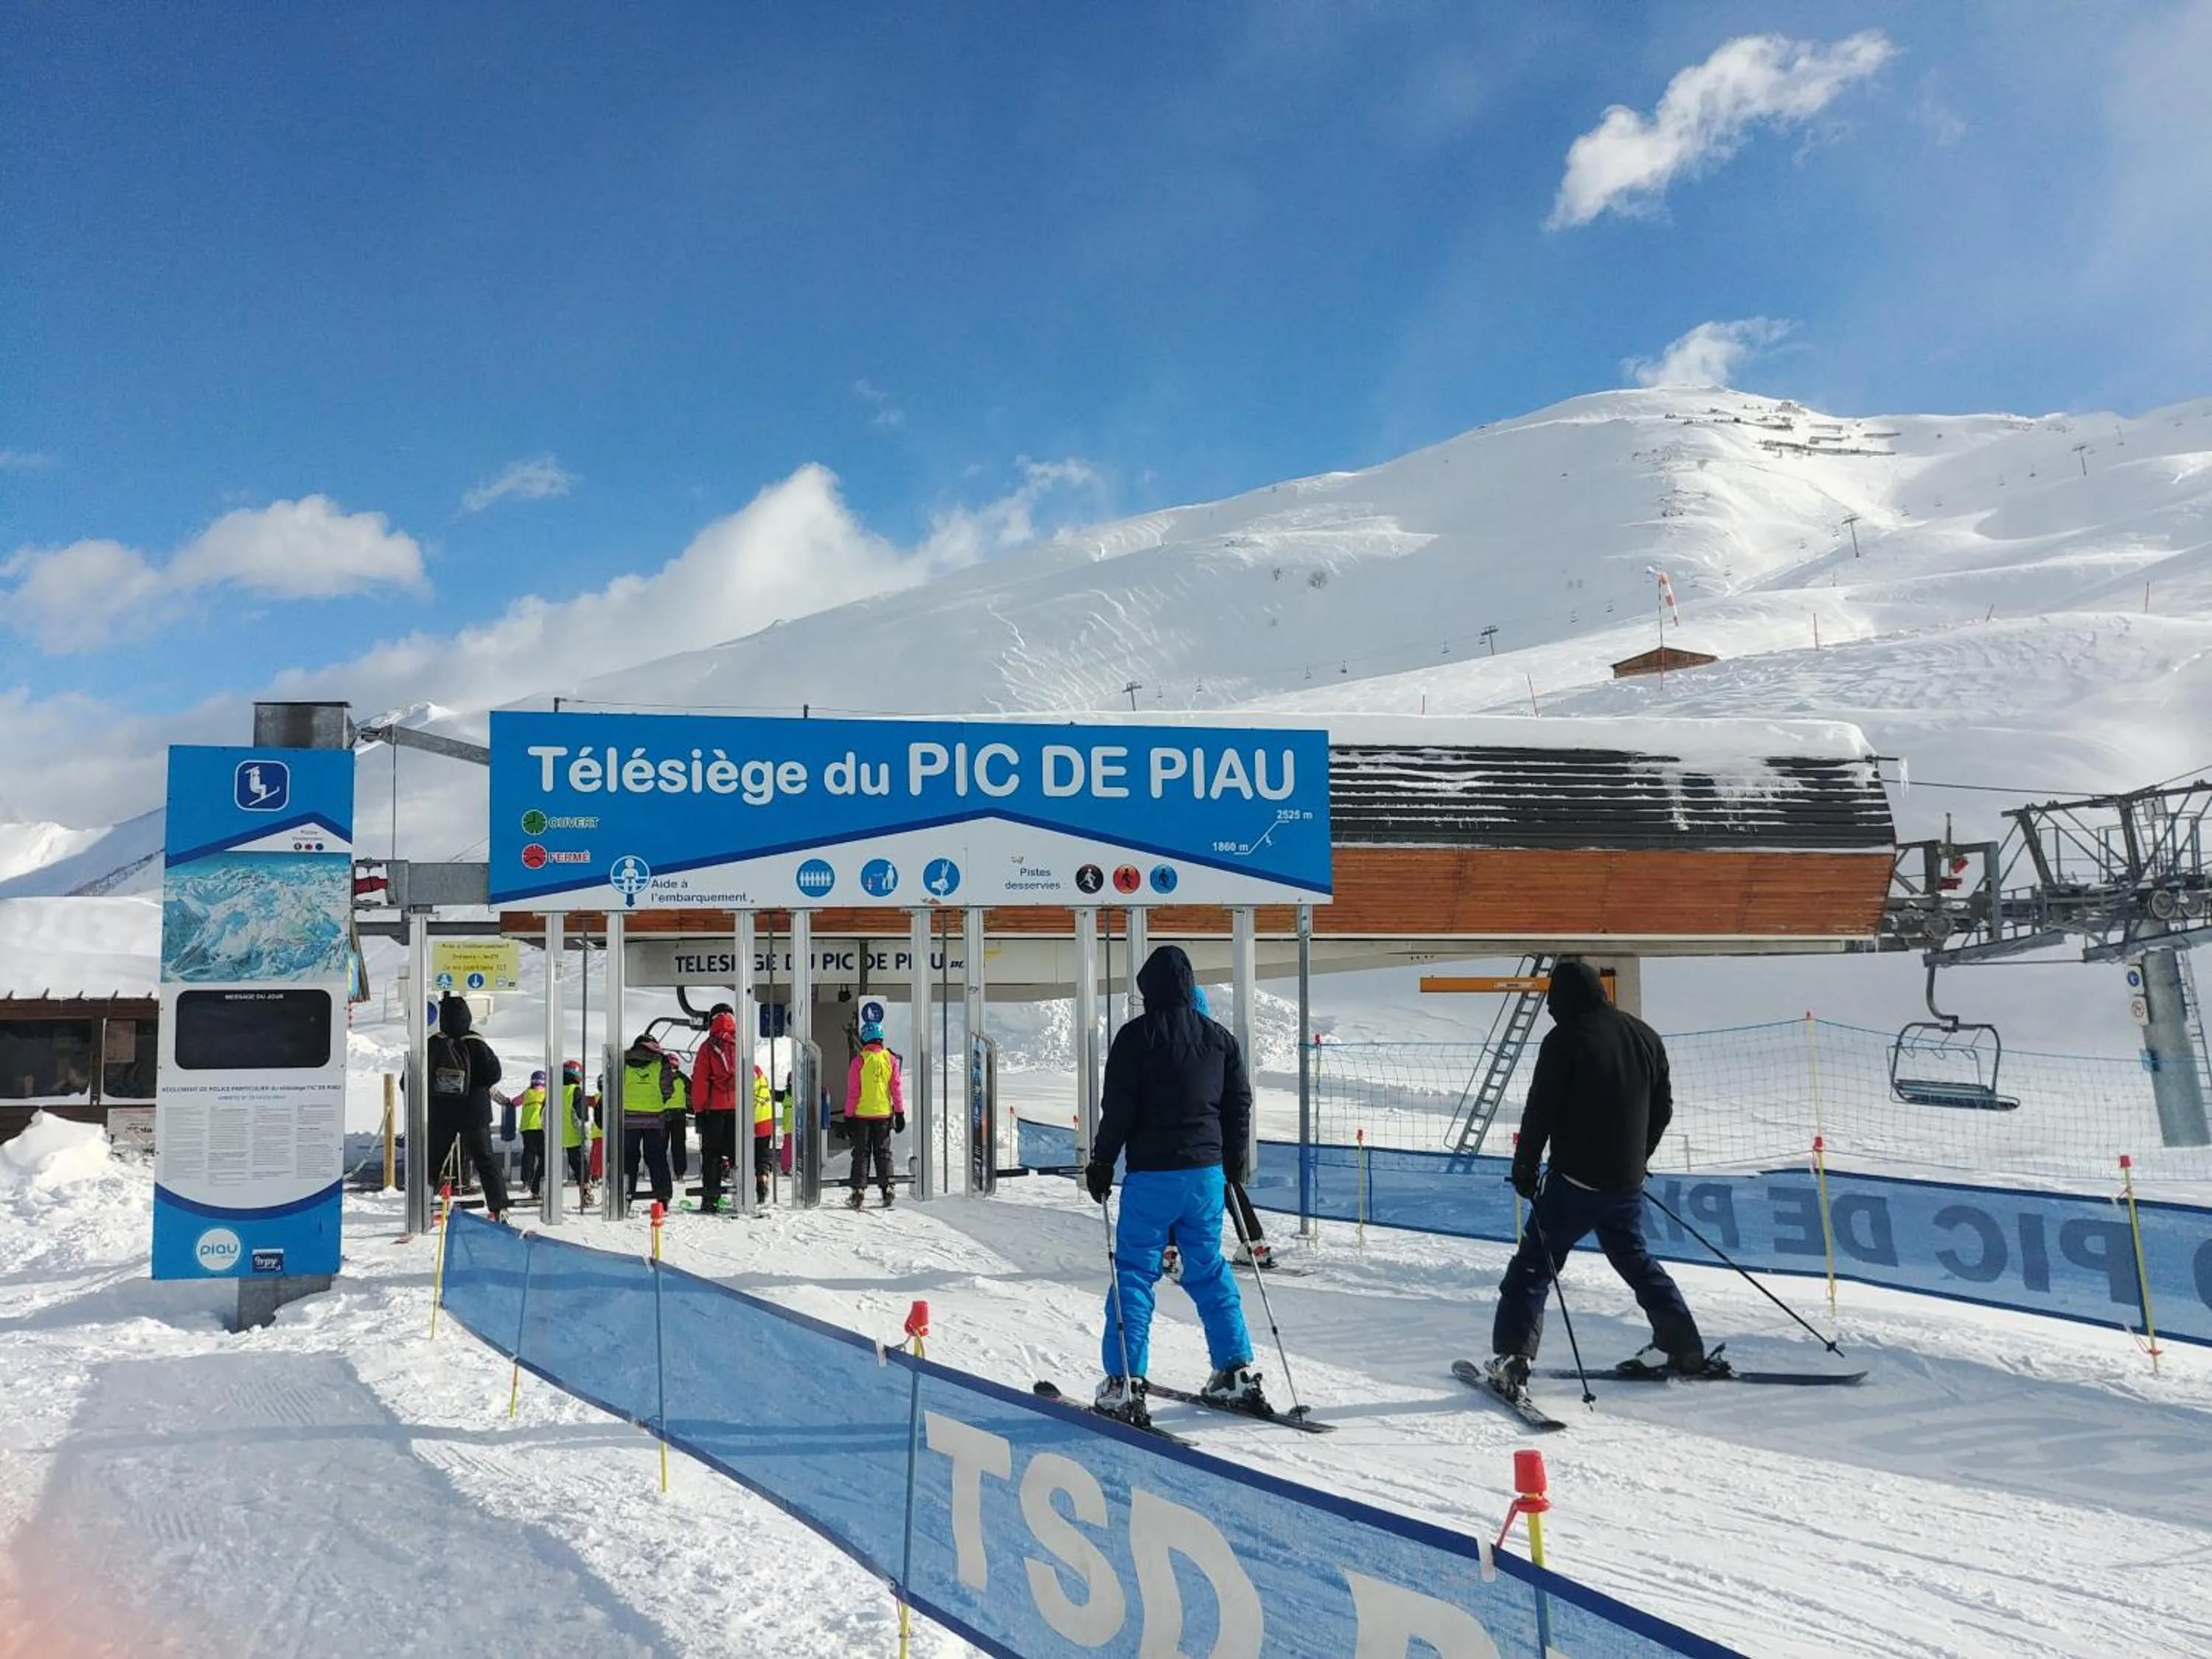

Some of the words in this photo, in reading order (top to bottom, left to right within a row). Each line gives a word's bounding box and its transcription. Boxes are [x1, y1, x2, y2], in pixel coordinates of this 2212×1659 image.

[527, 745, 808, 806] Télésiège
[823, 751, 891, 796] du
[908, 742, 1020, 797] PIC
[1041, 744, 1130, 799] DE
[1149, 746, 1295, 801] PIAU
[548, 816, 600, 829] OUVERT
[548, 849, 591, 863] FERMÉ
[1020, 867, 1051, 877] Pistes
[651, 879, 678, 888] Aide
[1004, 881, 1061, 890] desservies
[675, 953, 776, 973] TELESIGE
[822, 953, 855, 971] PIC
[894, 952, 944, 970] PIU
[924, 1411, 1263, 1659] TSD
